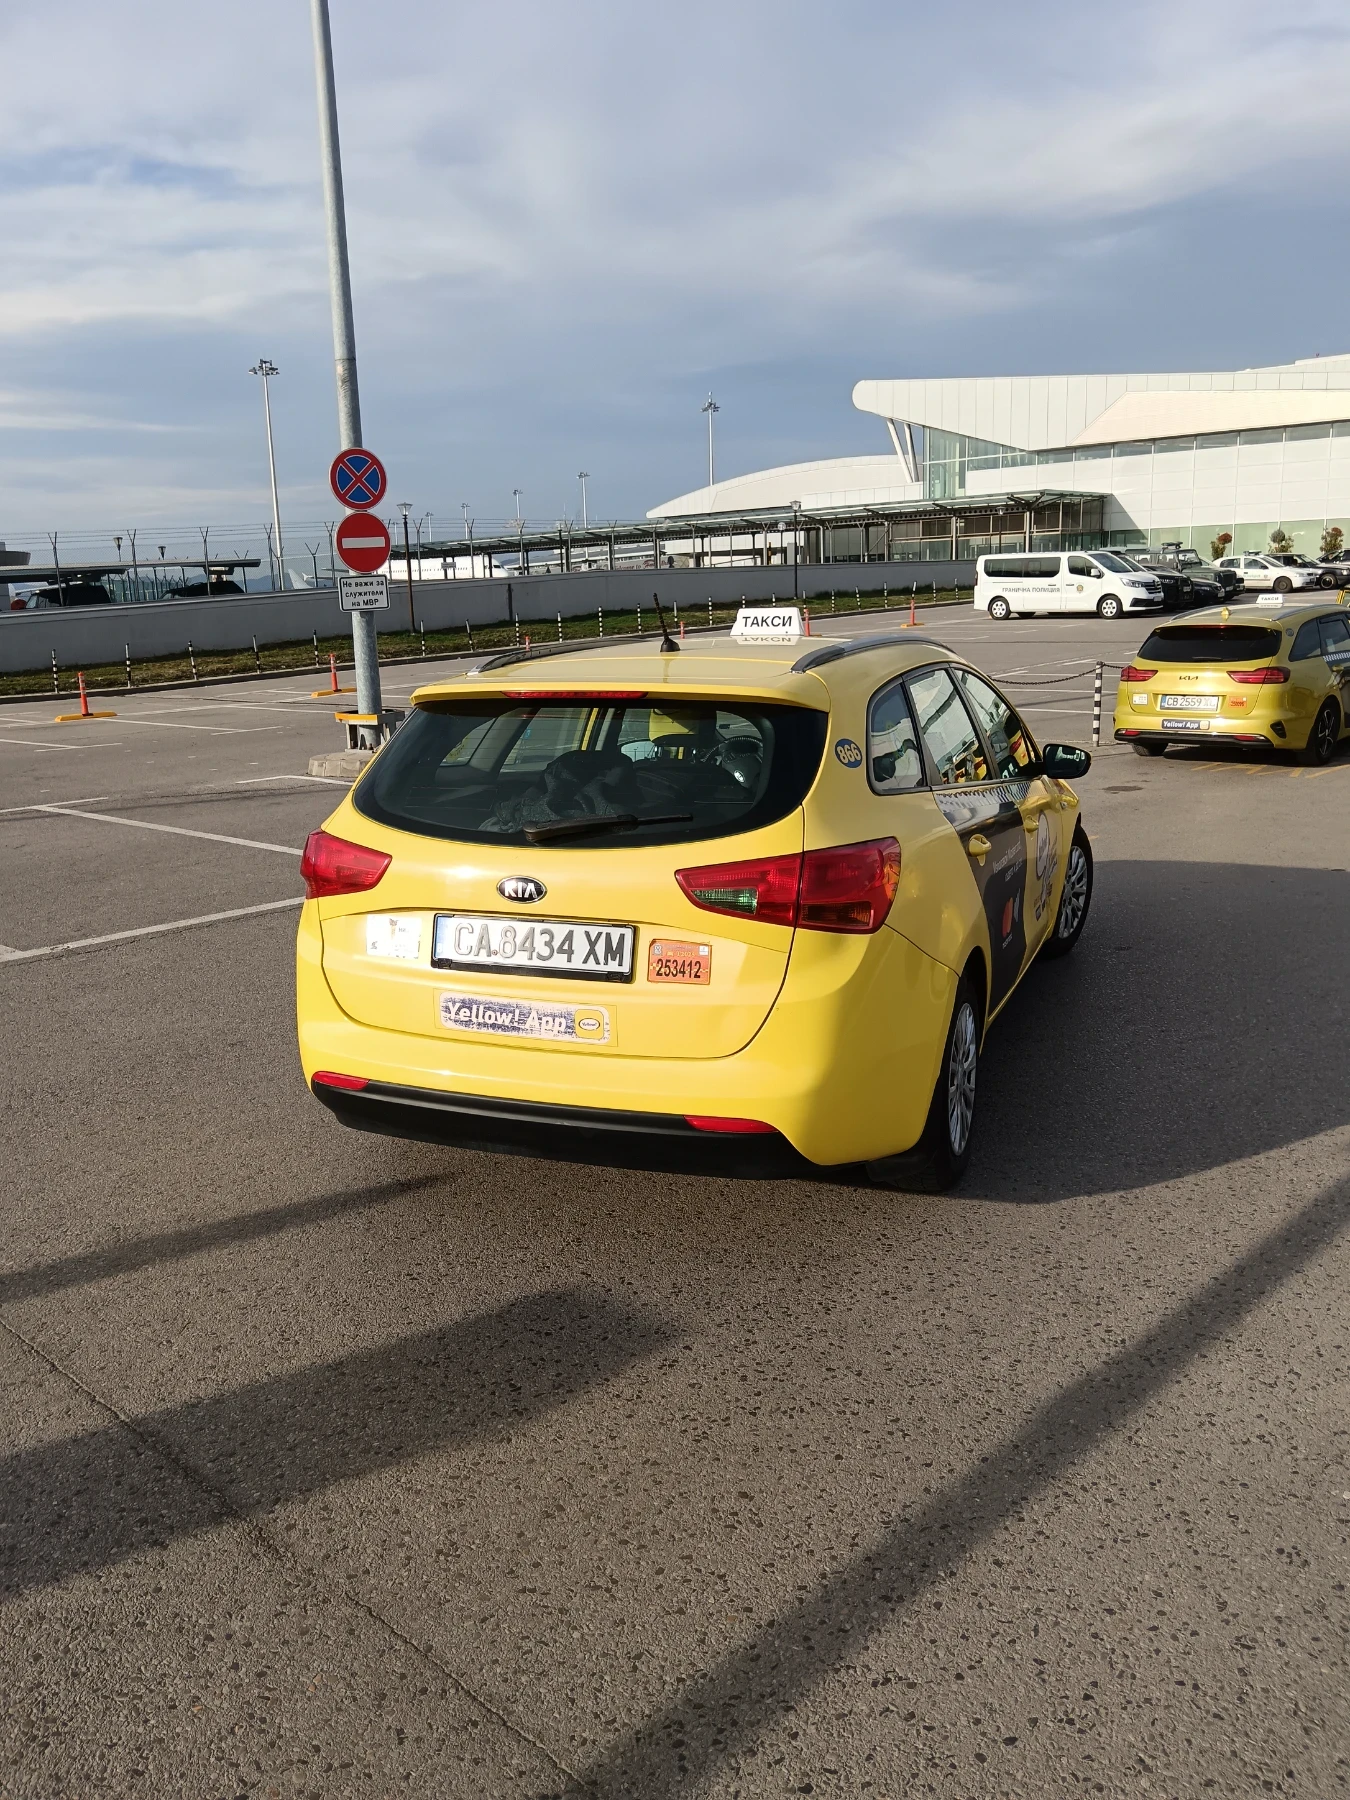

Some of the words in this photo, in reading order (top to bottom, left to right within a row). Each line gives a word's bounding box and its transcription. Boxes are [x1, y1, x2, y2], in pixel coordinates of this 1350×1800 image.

[342, 580, 353, 588] Не
[354, 580, 374, 588] важи
[345, 590, 384, 599] служители
[362, 598, 379, 606] МВР
[742, 614, 793, 628] ТАКСИ
[1179, 697, 1202, 708] 2559
[1186, 721, 1199, 730] App
[836, 743, 861, 765] 866
[502, 880, 539, 899] KIA
[582, 930, 626, 967] XM
[655, 958, 702, 979] 253412
[447, 1000, 520, 1028] Yellow!
[525, 1009, 567, 1037] App
